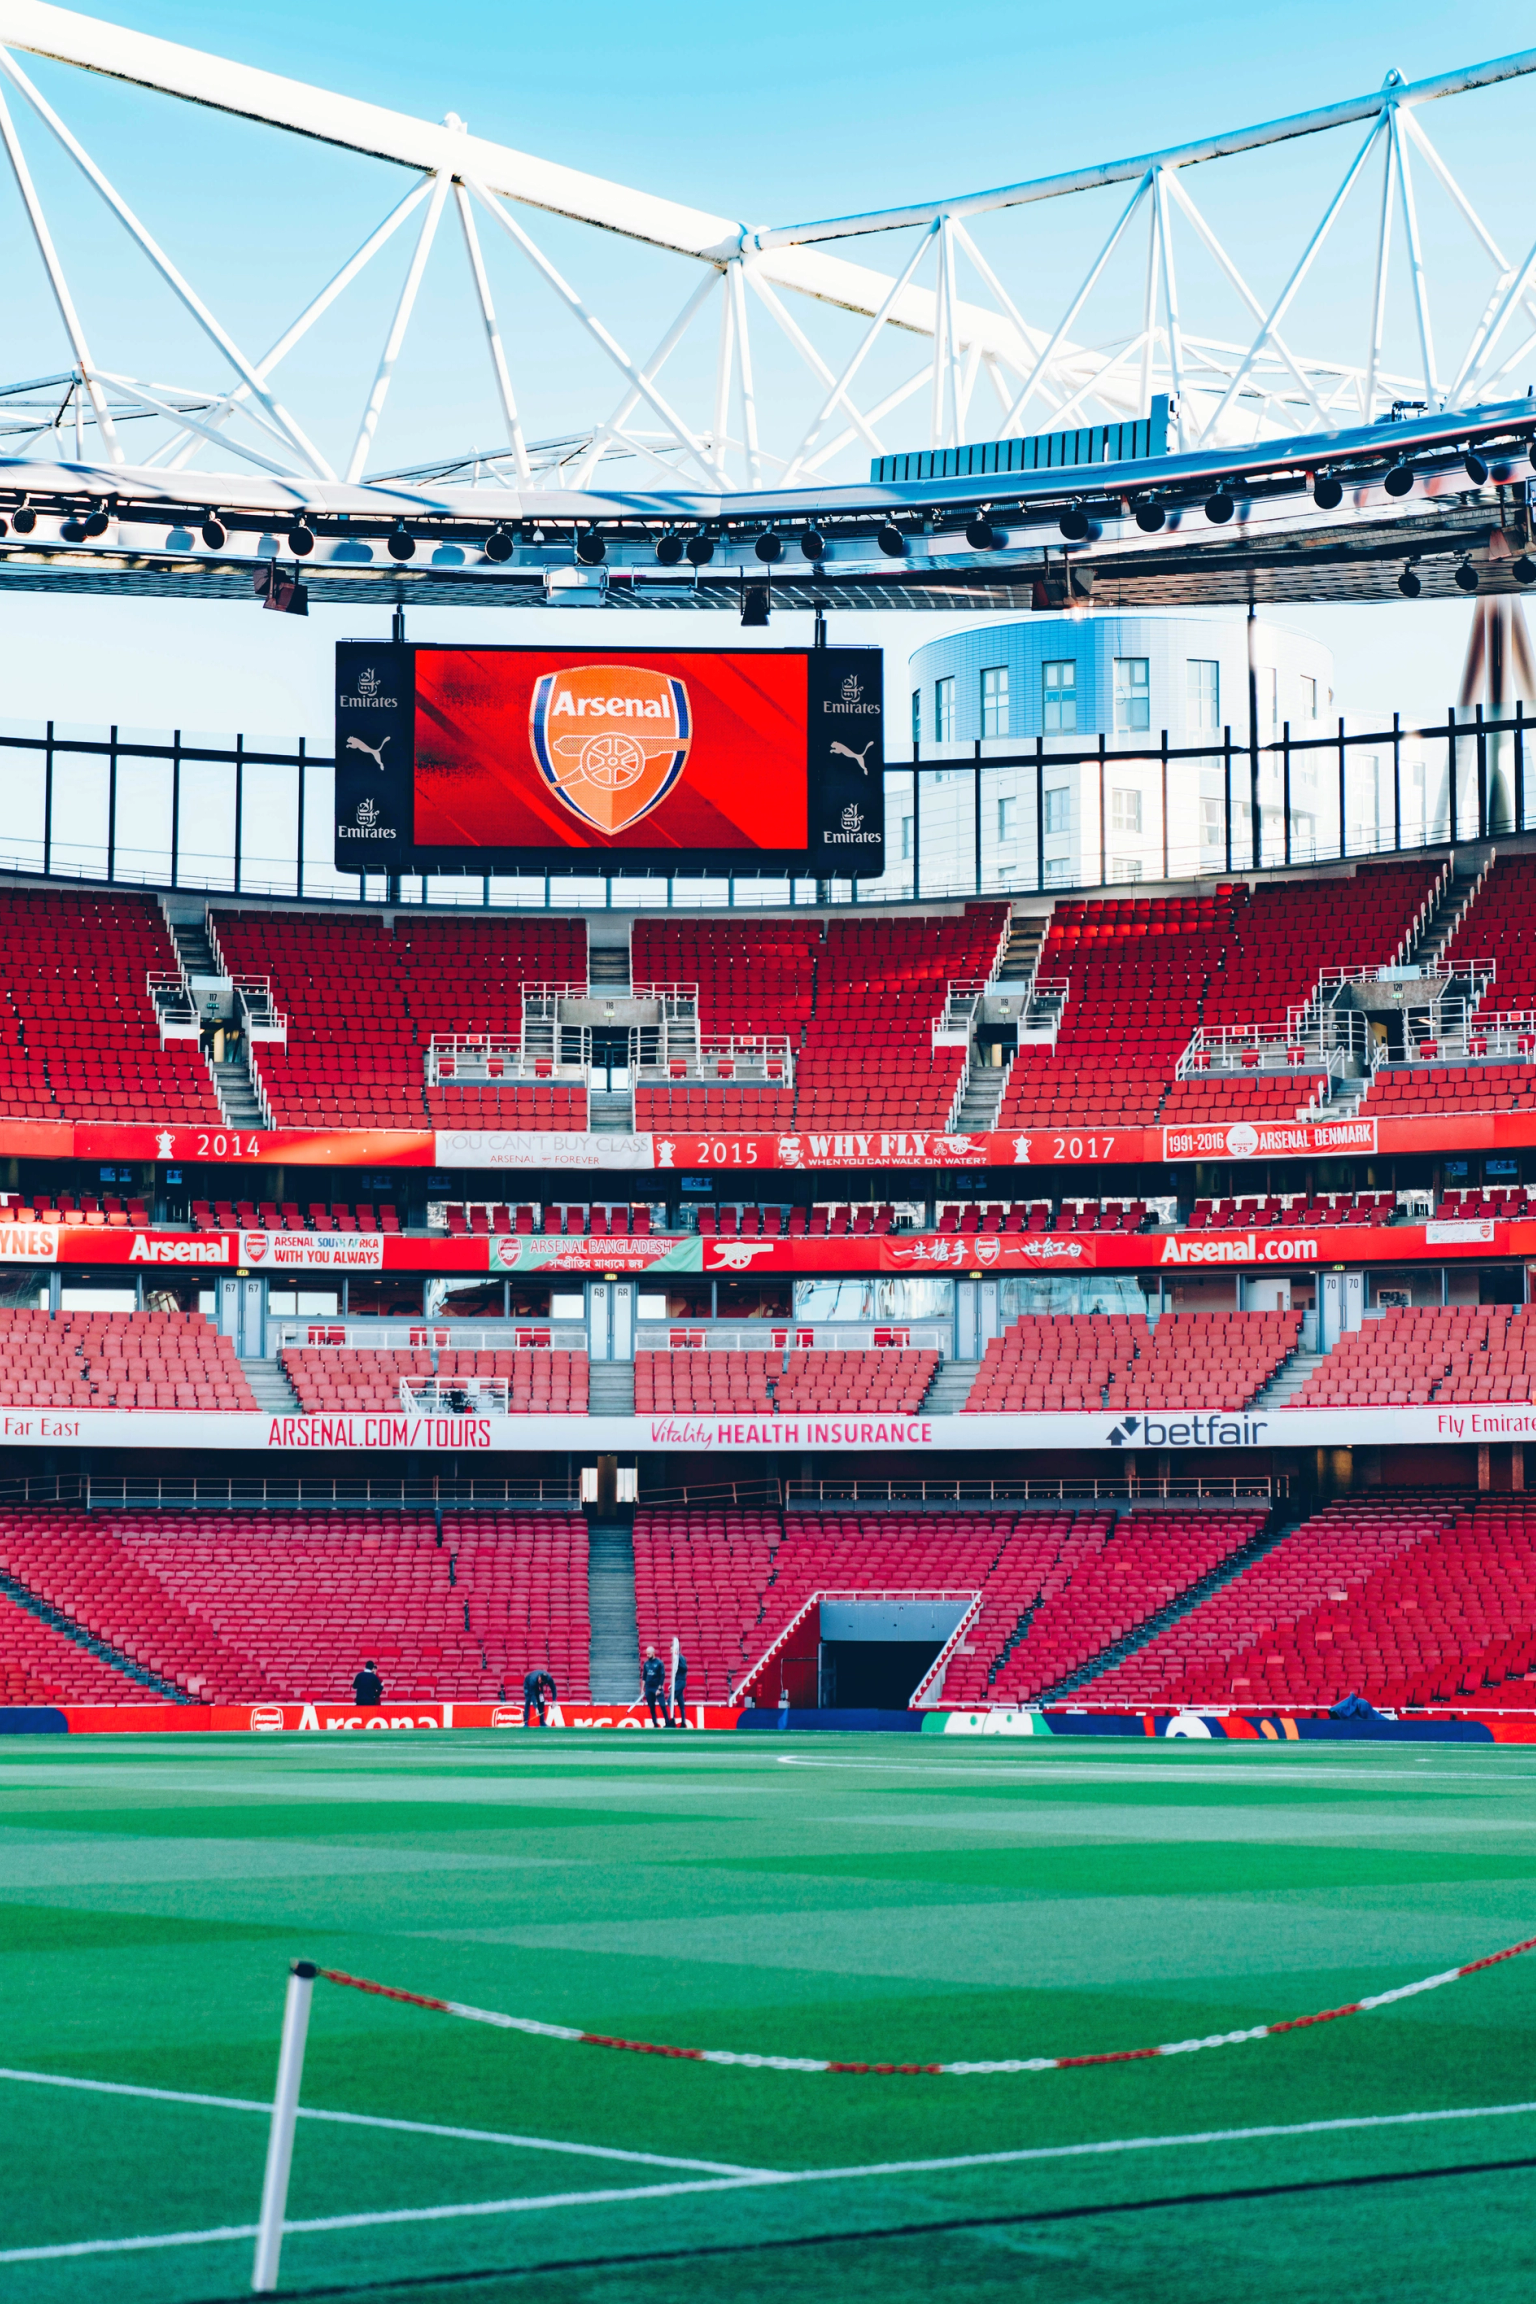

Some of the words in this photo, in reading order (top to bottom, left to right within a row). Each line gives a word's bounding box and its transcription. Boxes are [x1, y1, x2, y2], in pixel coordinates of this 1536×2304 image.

[340, 695, 398, 708] Emirates
[552, 691, 671, 718] Arsenal
[823, 701, 881, 714] Emirates
[338, 825, 397, 838] Emirates
[823, 831, 882, 843] Emirates
[197, 1134, 260, 1157] 2014
[441, 1135, 483, 1150] YOU
[488, 1135, 548, 1150] CAN'T
[554, 1136, 595, 1150] BUY
[596, 1137, 649, 1153] CLASS
[808, 1134, 874, 1157] WHY
[880, 1134, 930, 1156] FLY
[1168, 1132, 1224, 1153] 1991-2016
[1259, 1130, 1311, 1150] ARSENAL
[1314, 1124, 1372, 1146] DENMARK
[697, 1142, 758, 1164] 2015
[1053, 1137, 1115, 1159] 2017
[490, 1155, 536, 1163] ARSENAL
[555, 1155, 600, 1165] FOREVER
[808, 1158, 841, 1166] WHEN
[945, 1157, 987, 1165] WATER?
[128, 1234, 230, 1263] Arsenal
[274, 1236, 315, 1247] ARSENAL
[318, 1237, 346, 1248] SOUTH
[529, 1239, 588, 1254] ARSENAL
[588, 1239, 673, 1254] BANGLADESH
[1160, 1234, 1318, 1263] Arsenal.com
[274, 1250, 303, 1263] WITH
[307, 1250, 330, 1263] YOU
[333, 1251, 380, 1264] ALWAYS
[225, 1284, 236, 1293] 67
[248, 1284, 259, 1293] 67
[1326, 1279, 1337, 1289] 70
[1348, 1278, 1359, 1288] 70
[4, 1417, 32, 1436] Far
[41, 1418, 81, 1437] East
[268, 1418, 491, 1448] ARSENAL.COM/TOURS
[651, 1419, 713, 1449] Vitality
[718, 1423, 799, 1444] HEALTH
[807, 1423, 932, 1443] INSURANCE
[1144, 1415, 1268, 1446] betfair
[1438, 1415, 1464, 1438] Fly
